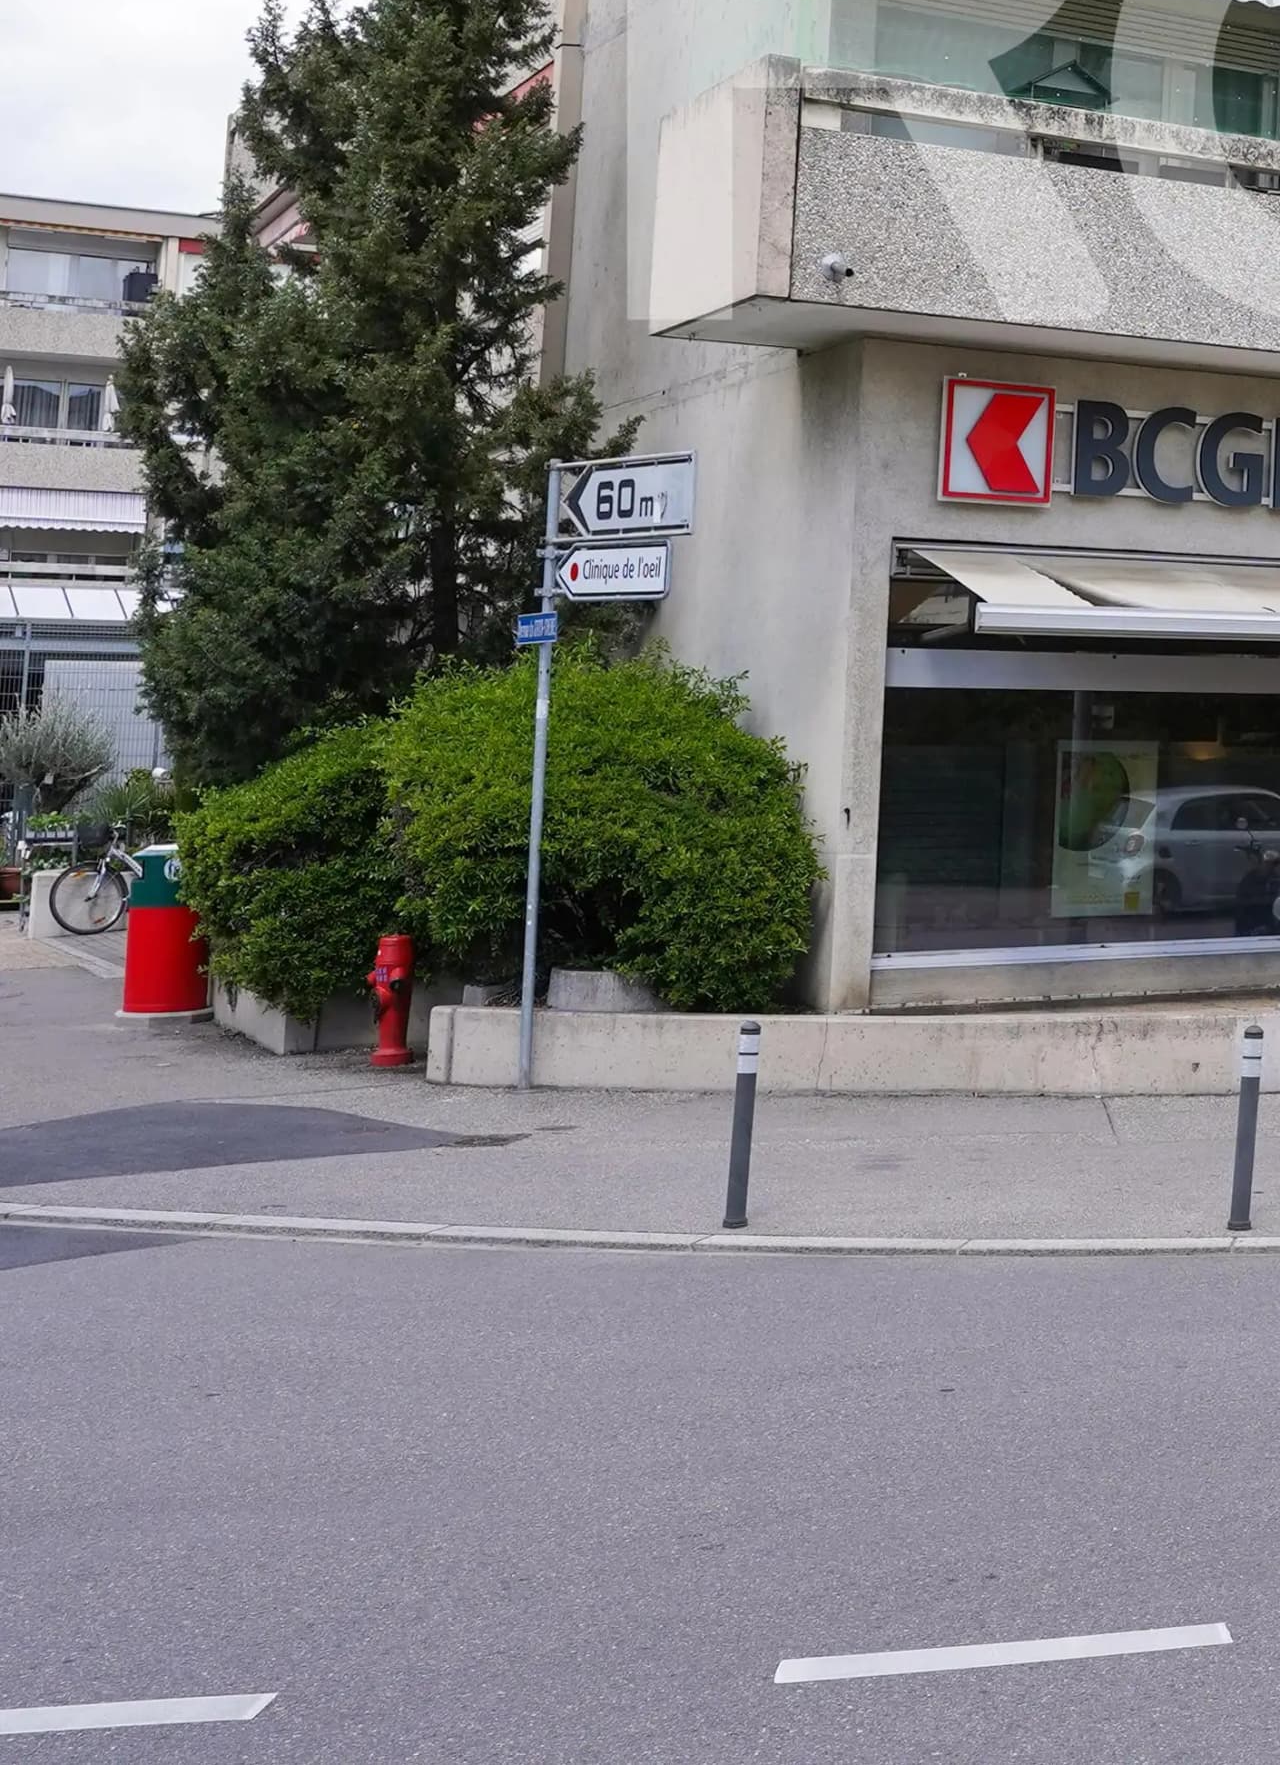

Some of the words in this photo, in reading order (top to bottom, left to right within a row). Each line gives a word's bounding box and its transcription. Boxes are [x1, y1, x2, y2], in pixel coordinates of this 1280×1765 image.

[596, 479, 635, 521] 60
[583, 558, 619, 585] Clinique
[622, 556, 635, 579] de
